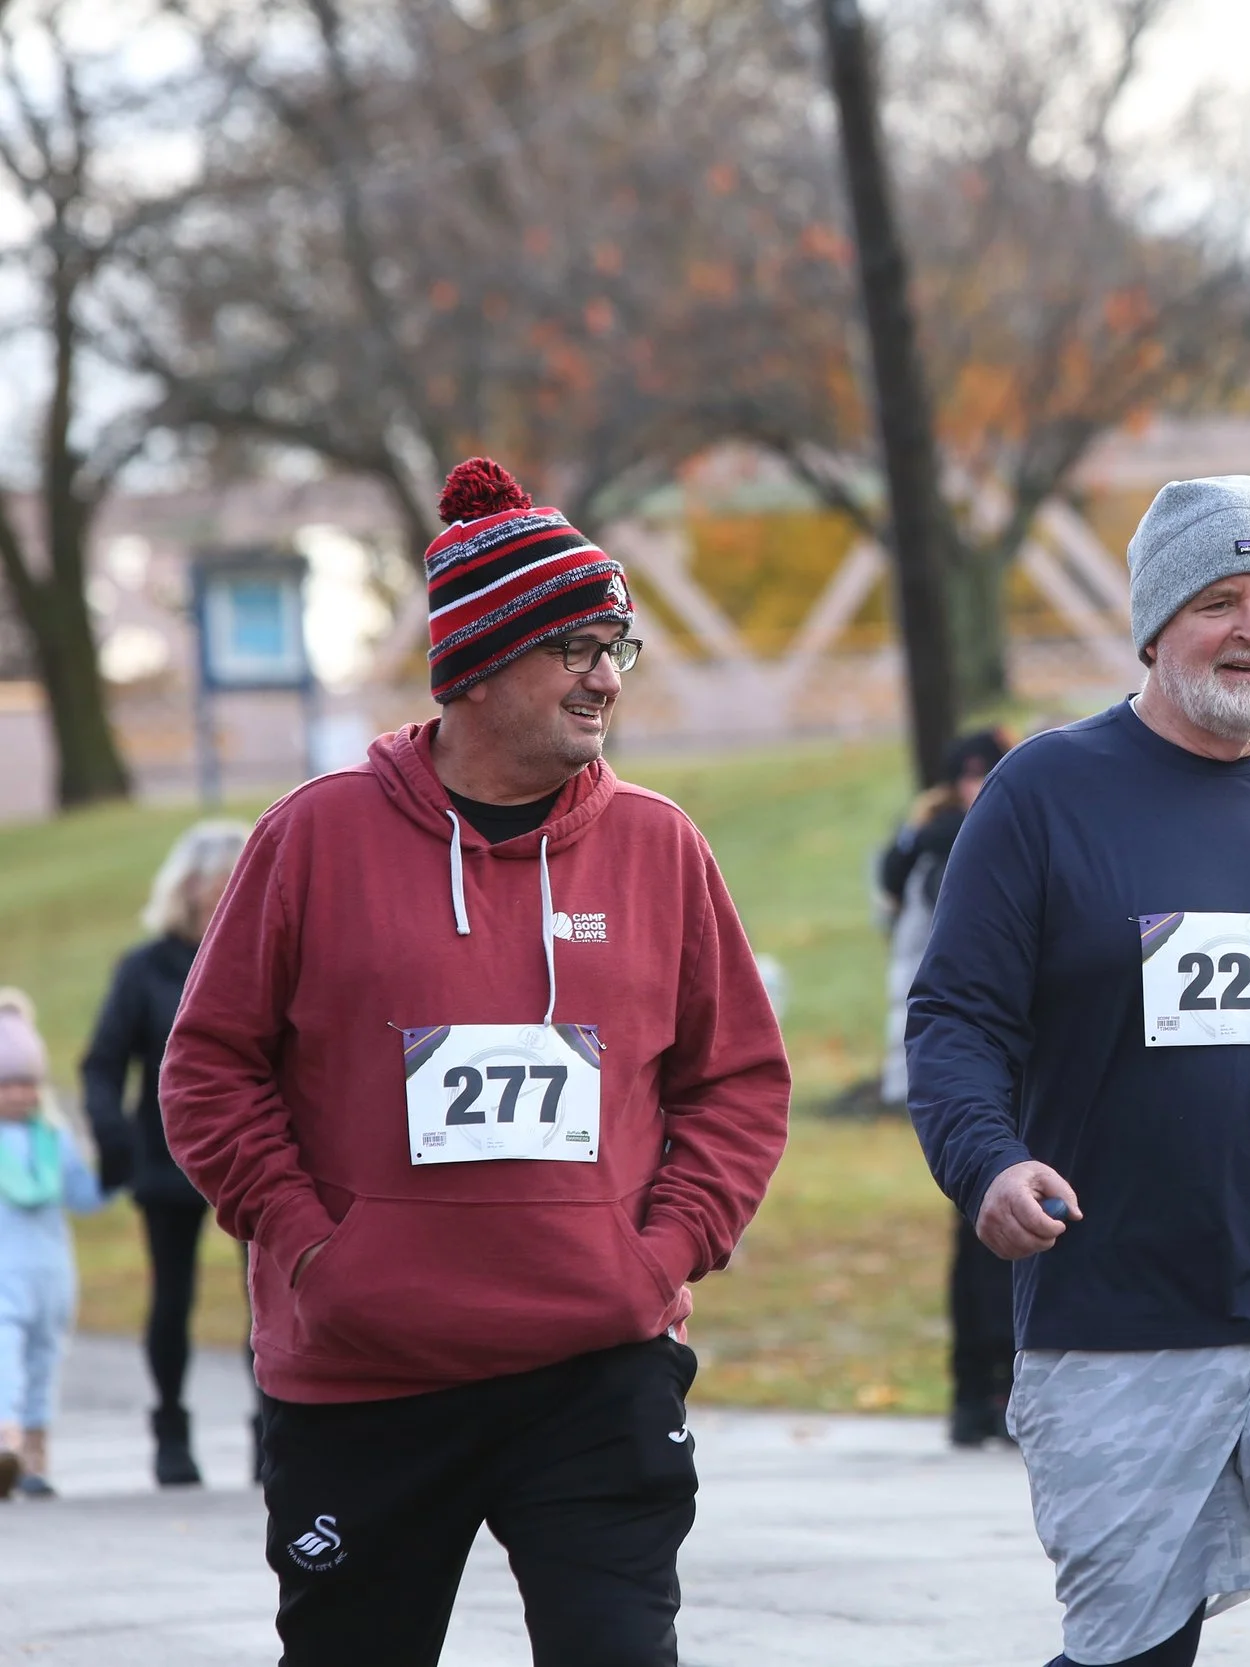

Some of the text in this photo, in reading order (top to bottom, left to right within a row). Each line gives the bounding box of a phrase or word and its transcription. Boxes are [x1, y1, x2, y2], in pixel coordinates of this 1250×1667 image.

[572, 913, 606, 922] CAMP
[574, 922, 606, 931] GOOD
[575, 931, 607, 939] DAYS
[443, 1065, 568, 1126] 277
[315, 1561, 332, 1572] CITY
